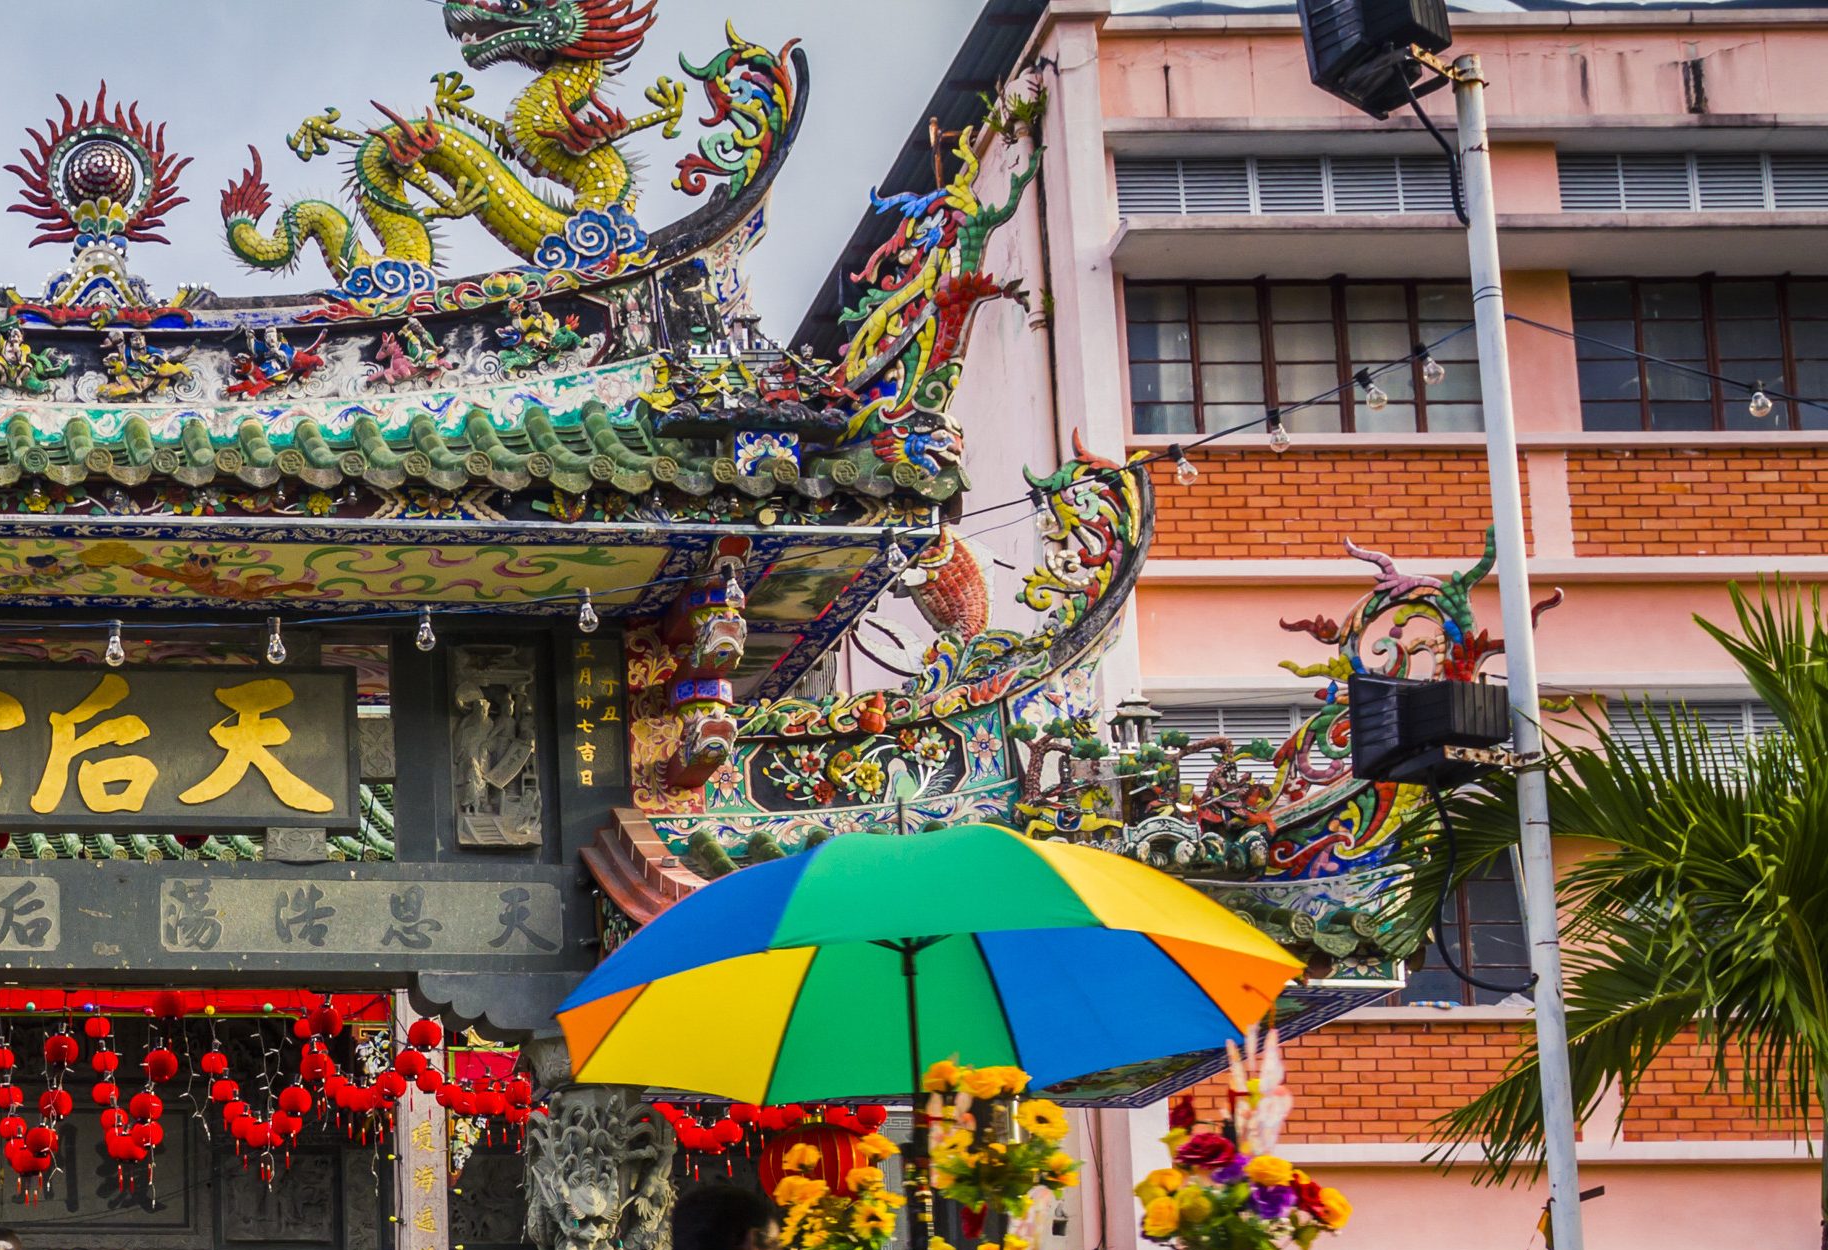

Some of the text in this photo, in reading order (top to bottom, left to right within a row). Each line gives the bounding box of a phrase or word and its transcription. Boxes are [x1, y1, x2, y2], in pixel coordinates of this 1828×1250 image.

[575, 642, 596, 786] 正月廿七吉日
[600, 680, 620, 721] 丁丑
